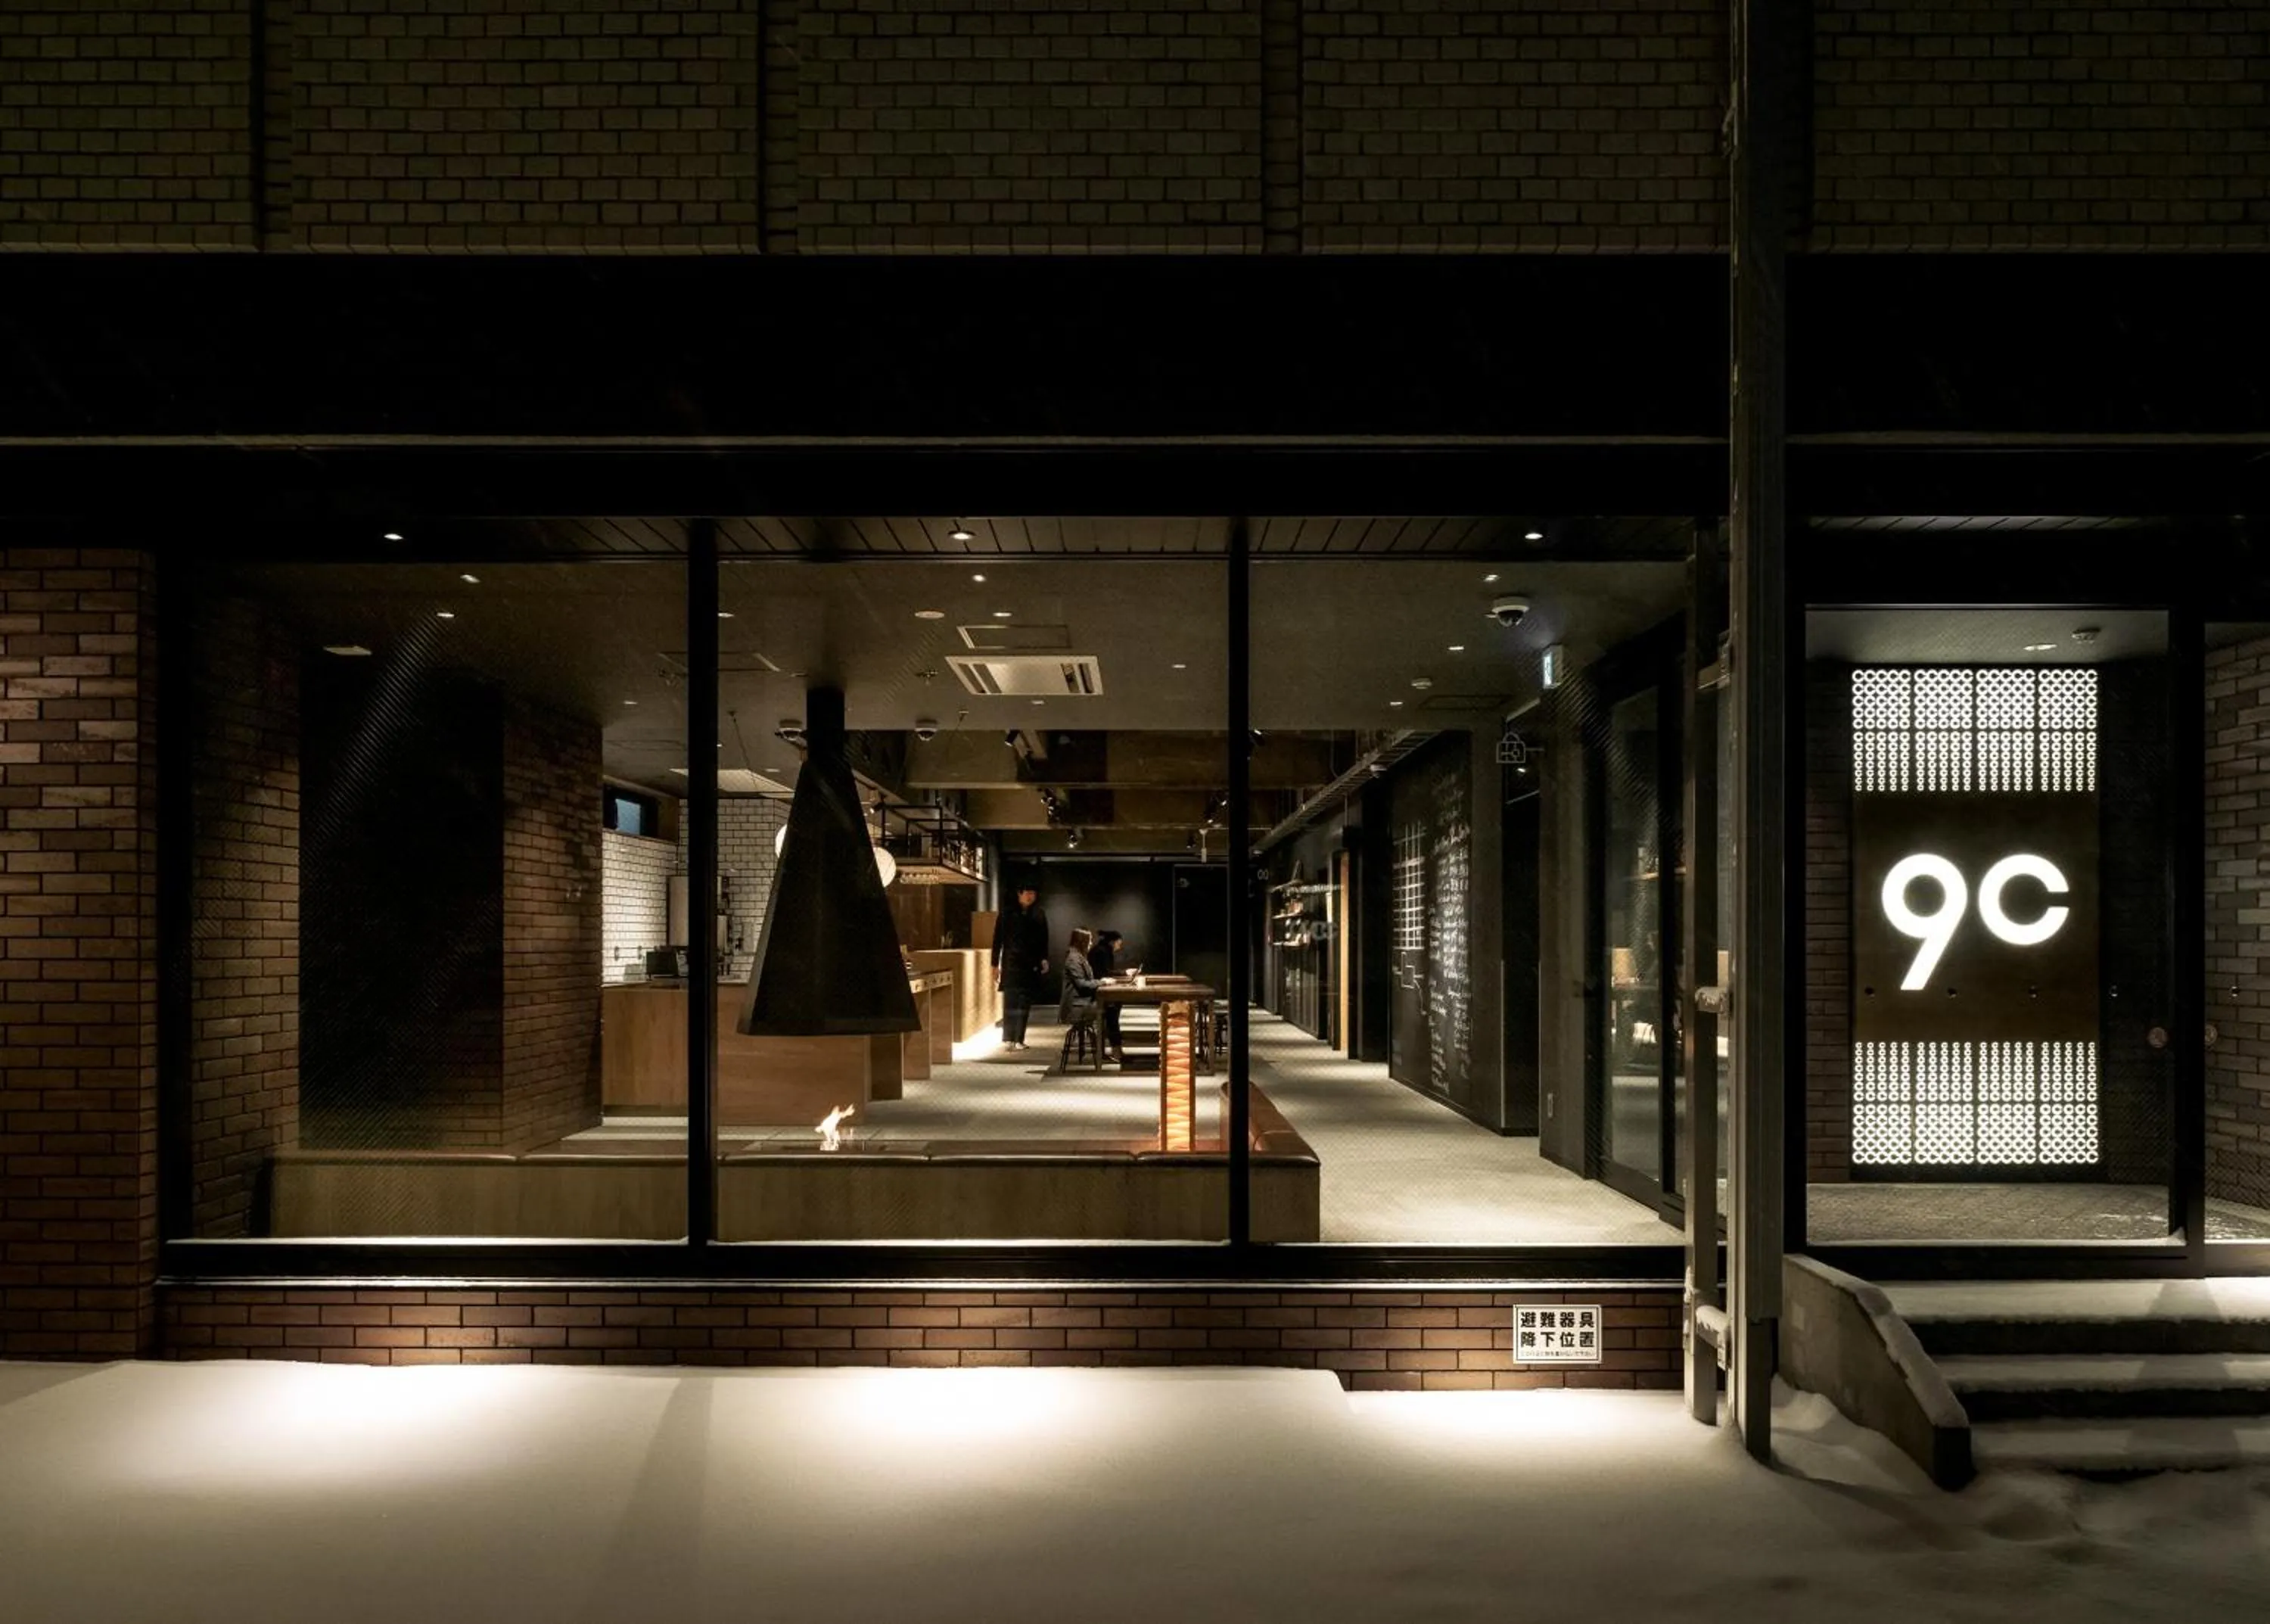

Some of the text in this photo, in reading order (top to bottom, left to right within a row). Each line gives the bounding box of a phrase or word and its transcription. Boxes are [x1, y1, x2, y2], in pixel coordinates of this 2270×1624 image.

[1520, 1311, 1594, 1328] 避難器具
[1520, 1331, 1594, 1348] 降下位置
